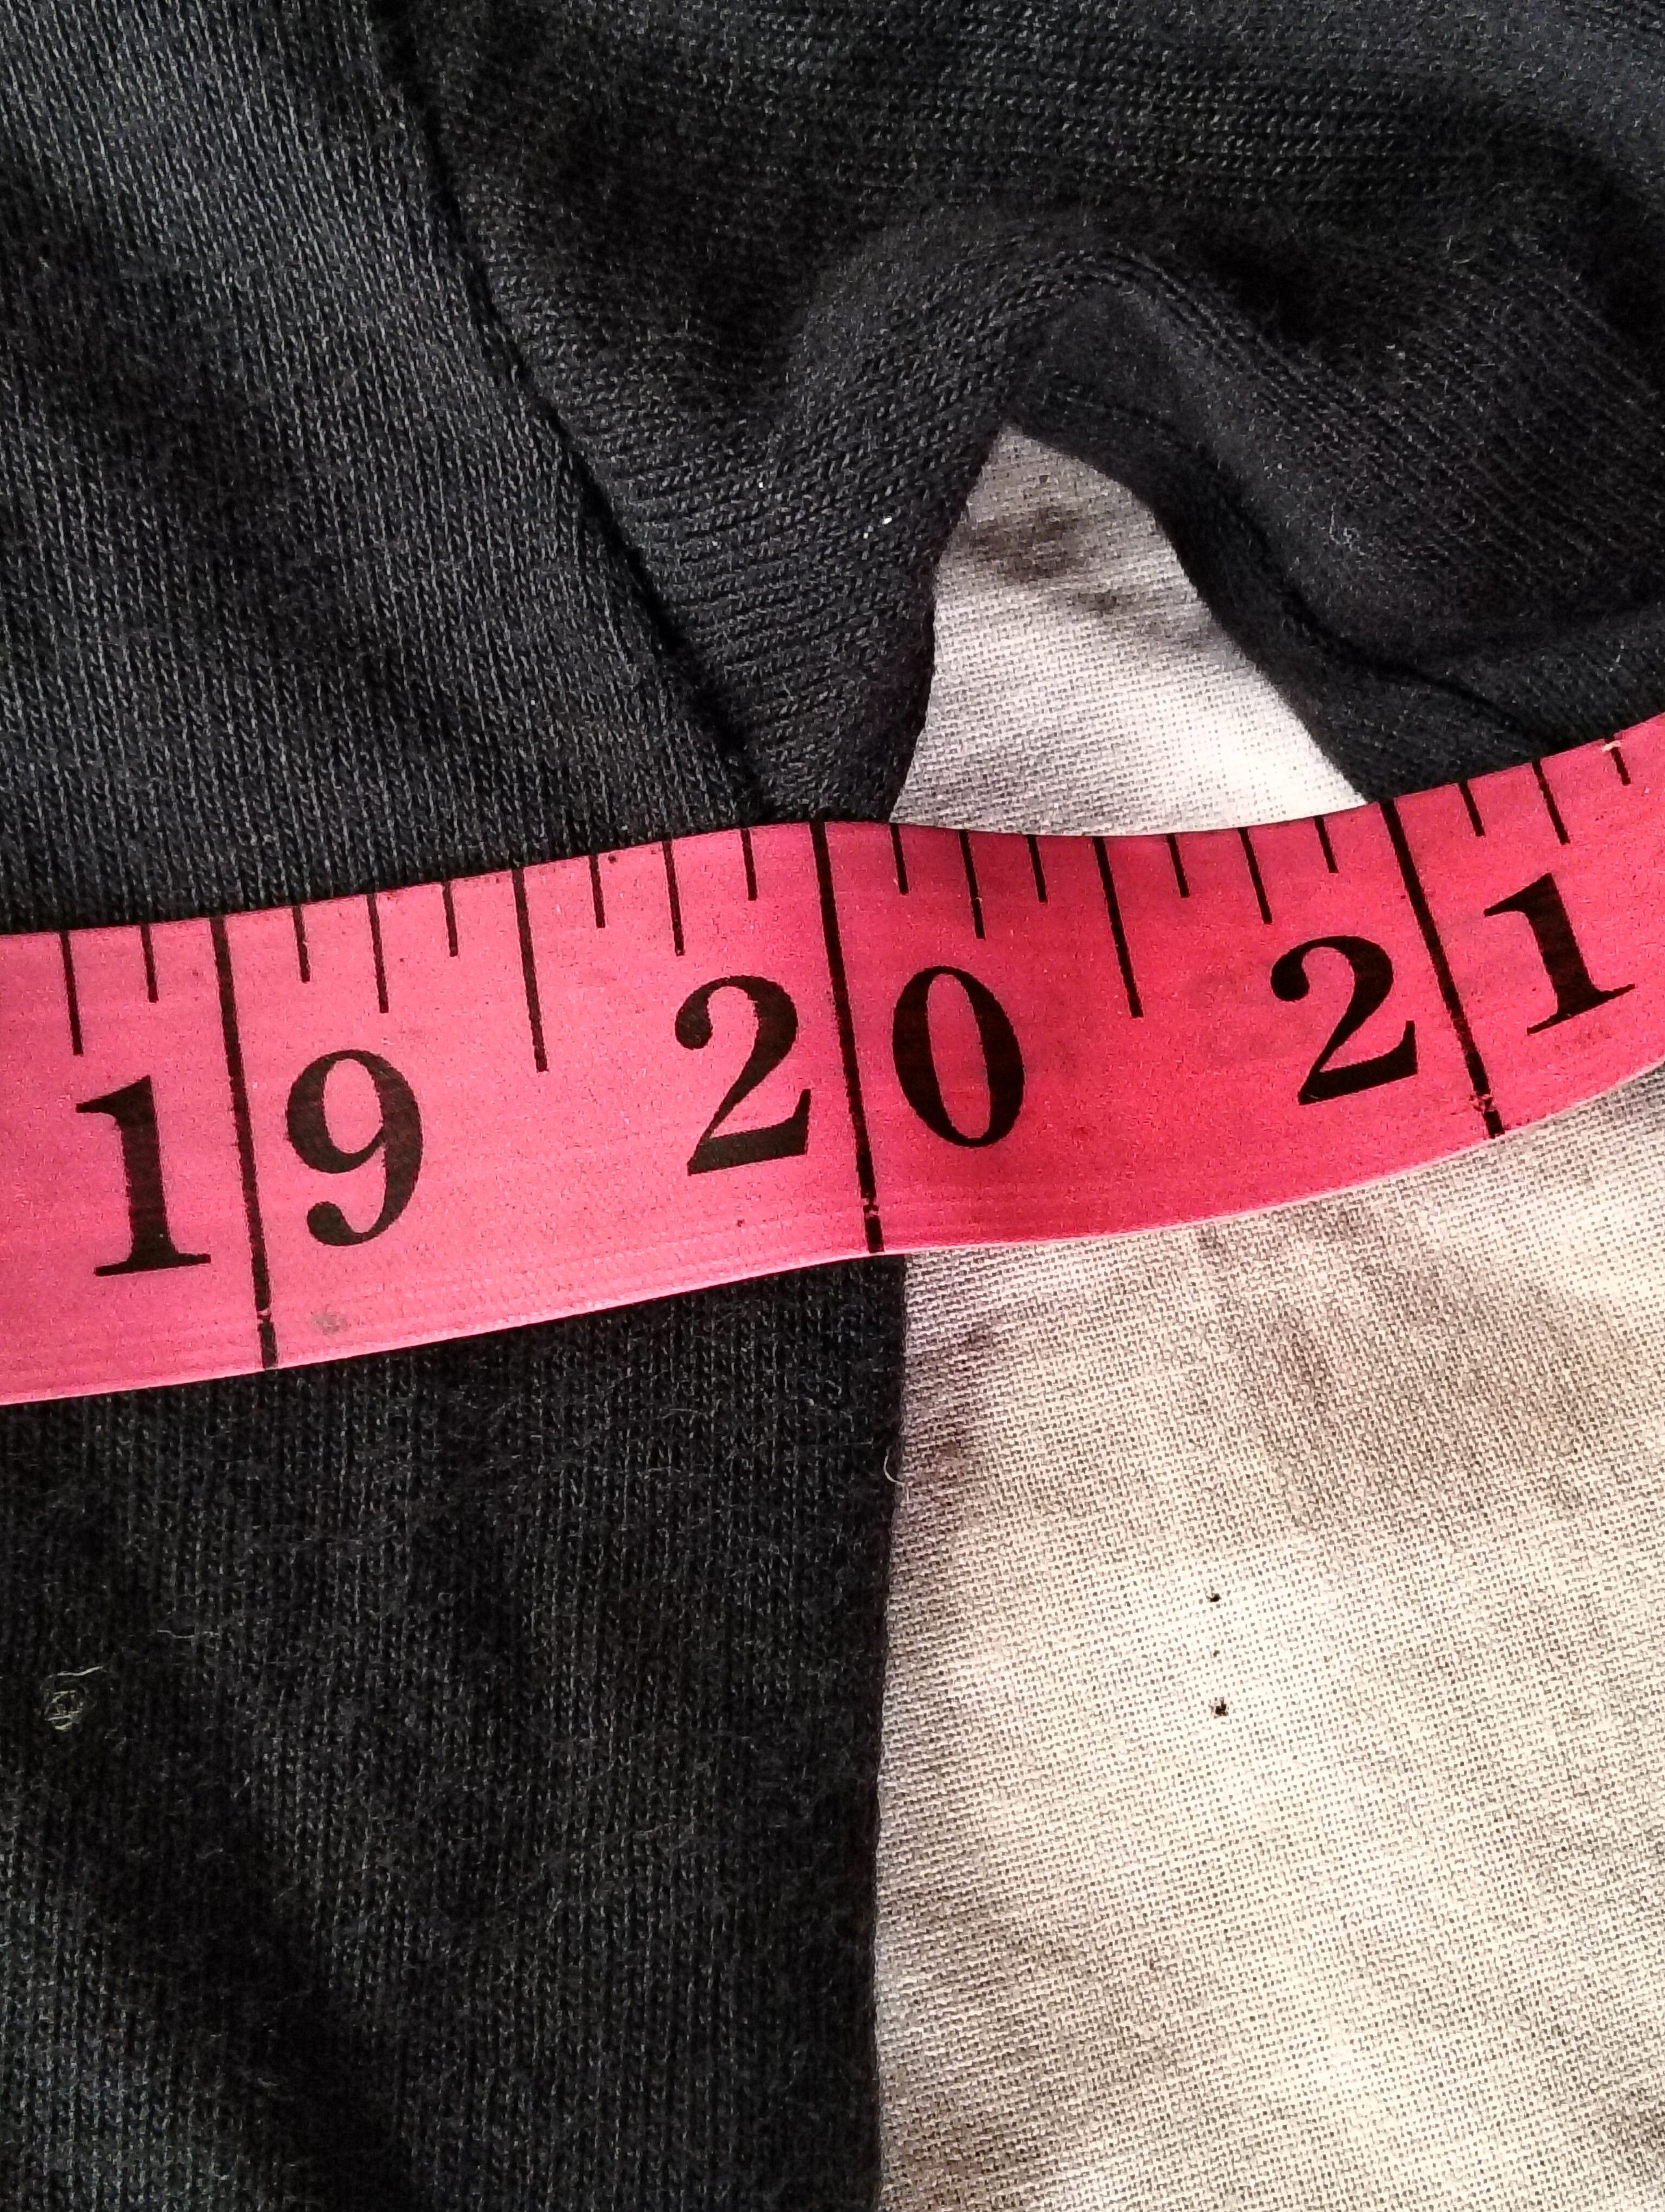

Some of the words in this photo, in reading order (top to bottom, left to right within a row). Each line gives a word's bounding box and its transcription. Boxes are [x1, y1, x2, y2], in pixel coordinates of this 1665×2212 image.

[77, 1050, 422, 1276] 19
[675, 966, 1025, 1174] 20
[1271, 874, 1632, 1105] 21
